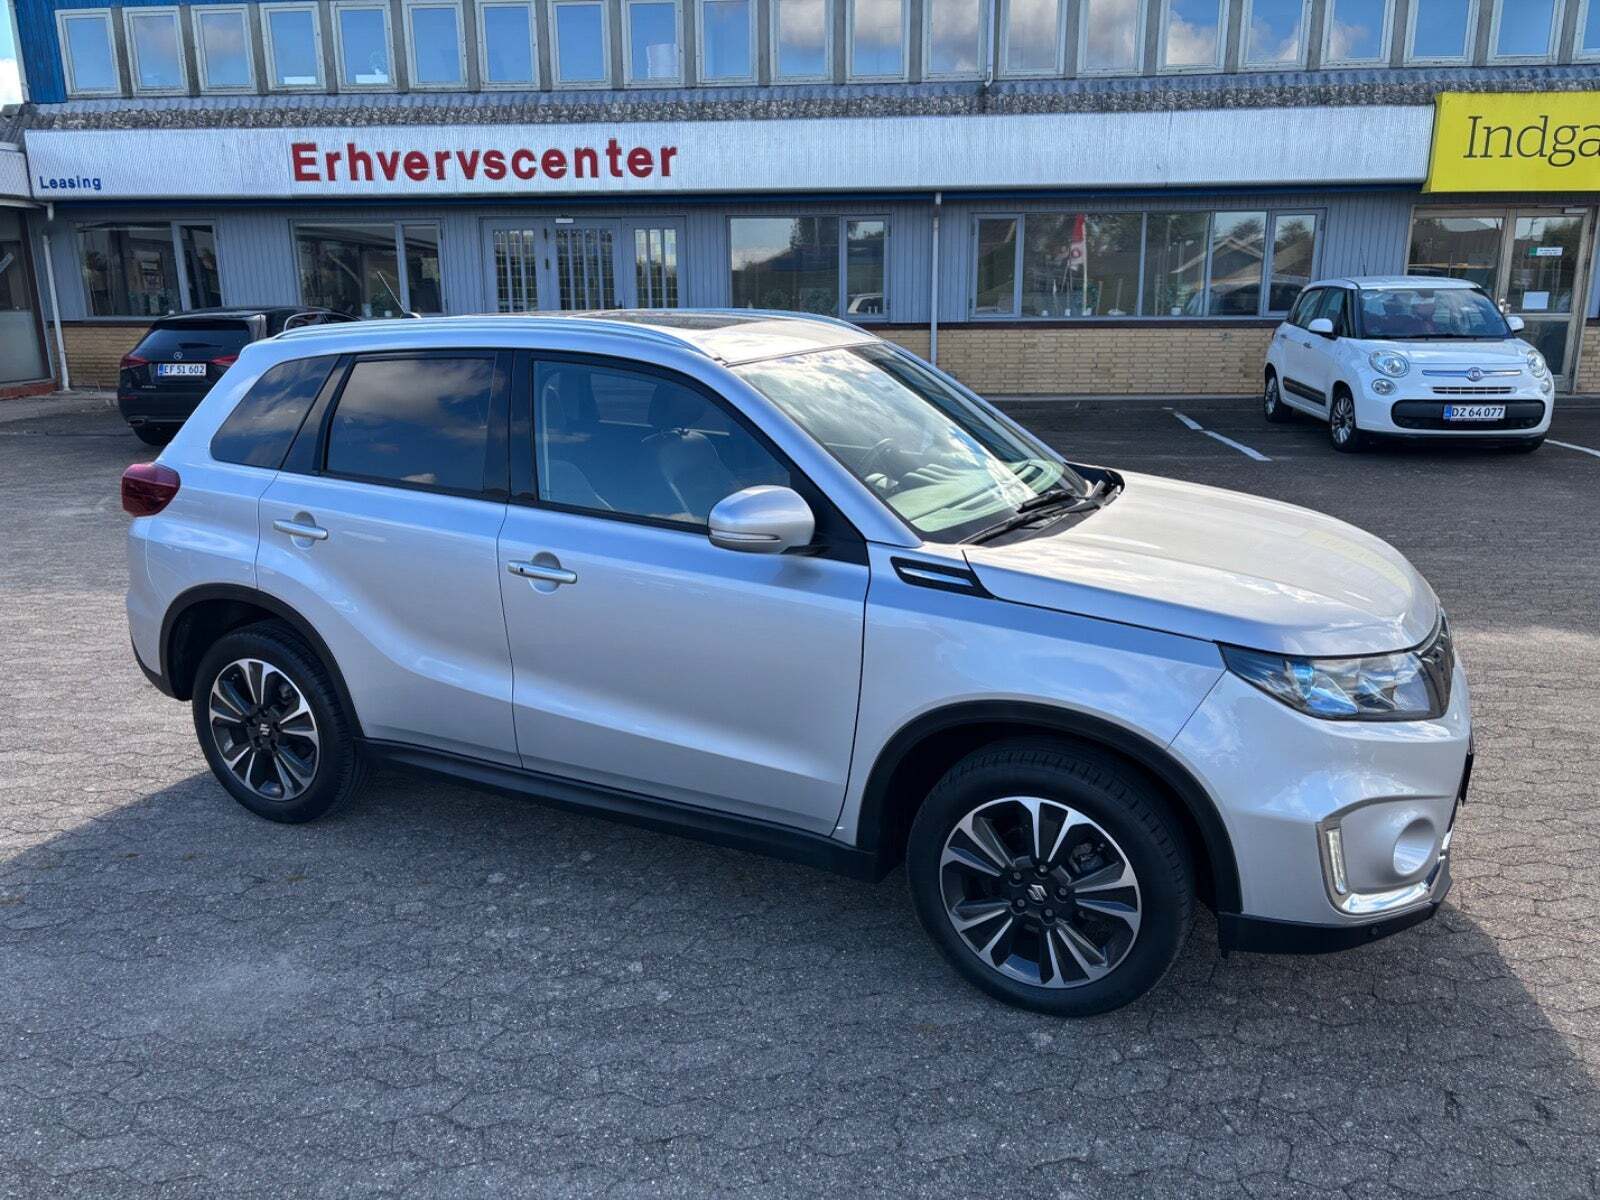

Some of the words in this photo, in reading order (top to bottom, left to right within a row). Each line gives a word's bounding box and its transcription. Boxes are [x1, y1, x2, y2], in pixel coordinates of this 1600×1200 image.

[1463, 115, 1600, 167] Indga
[291, 138, 678, 182] Erhvervscenter
[39, 175, 102, 190] Leasing
[163, 364, 174, 374] EF
[176, 364, 187, 374] 51
[188, 364, 205, 374] 602
[1451, 407, 1467, 417] DZ
[1468, 407, 1482, 417] 64
[1484, 407, 1504, 417] 077
